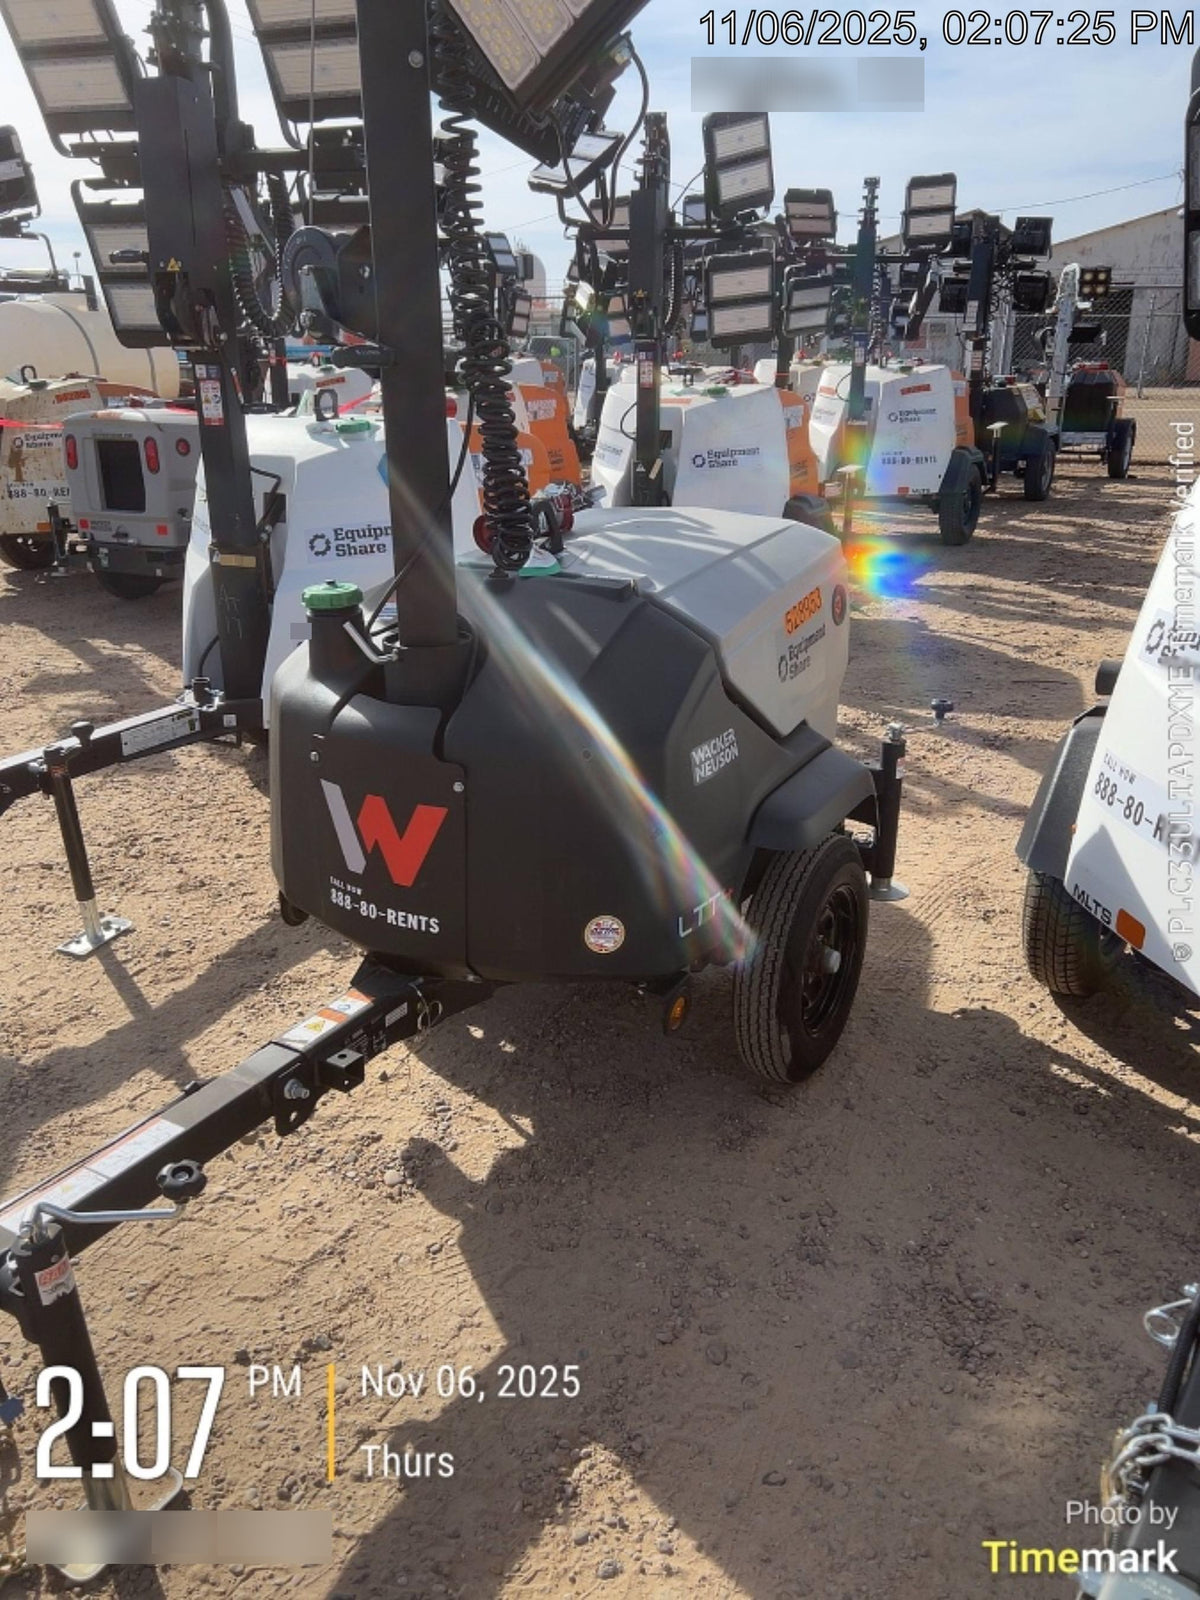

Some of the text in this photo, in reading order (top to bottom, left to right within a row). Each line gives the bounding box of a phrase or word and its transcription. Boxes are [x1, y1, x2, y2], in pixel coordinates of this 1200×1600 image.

[706, 447, 760, 461] Equipment
[708, 458, 739, 469] Share
[335, 543, 387, 557] Share
[788, 623, 826, 662] Equipment
[789, 655, 812, 680] Share
[692, 728, 736, 766] WACKER
[693, 743, 739, 783] NEUSON
[330, 888, 441, 934] 888-80-RENTS
[1072, 884, 1112, 926] MLTS
